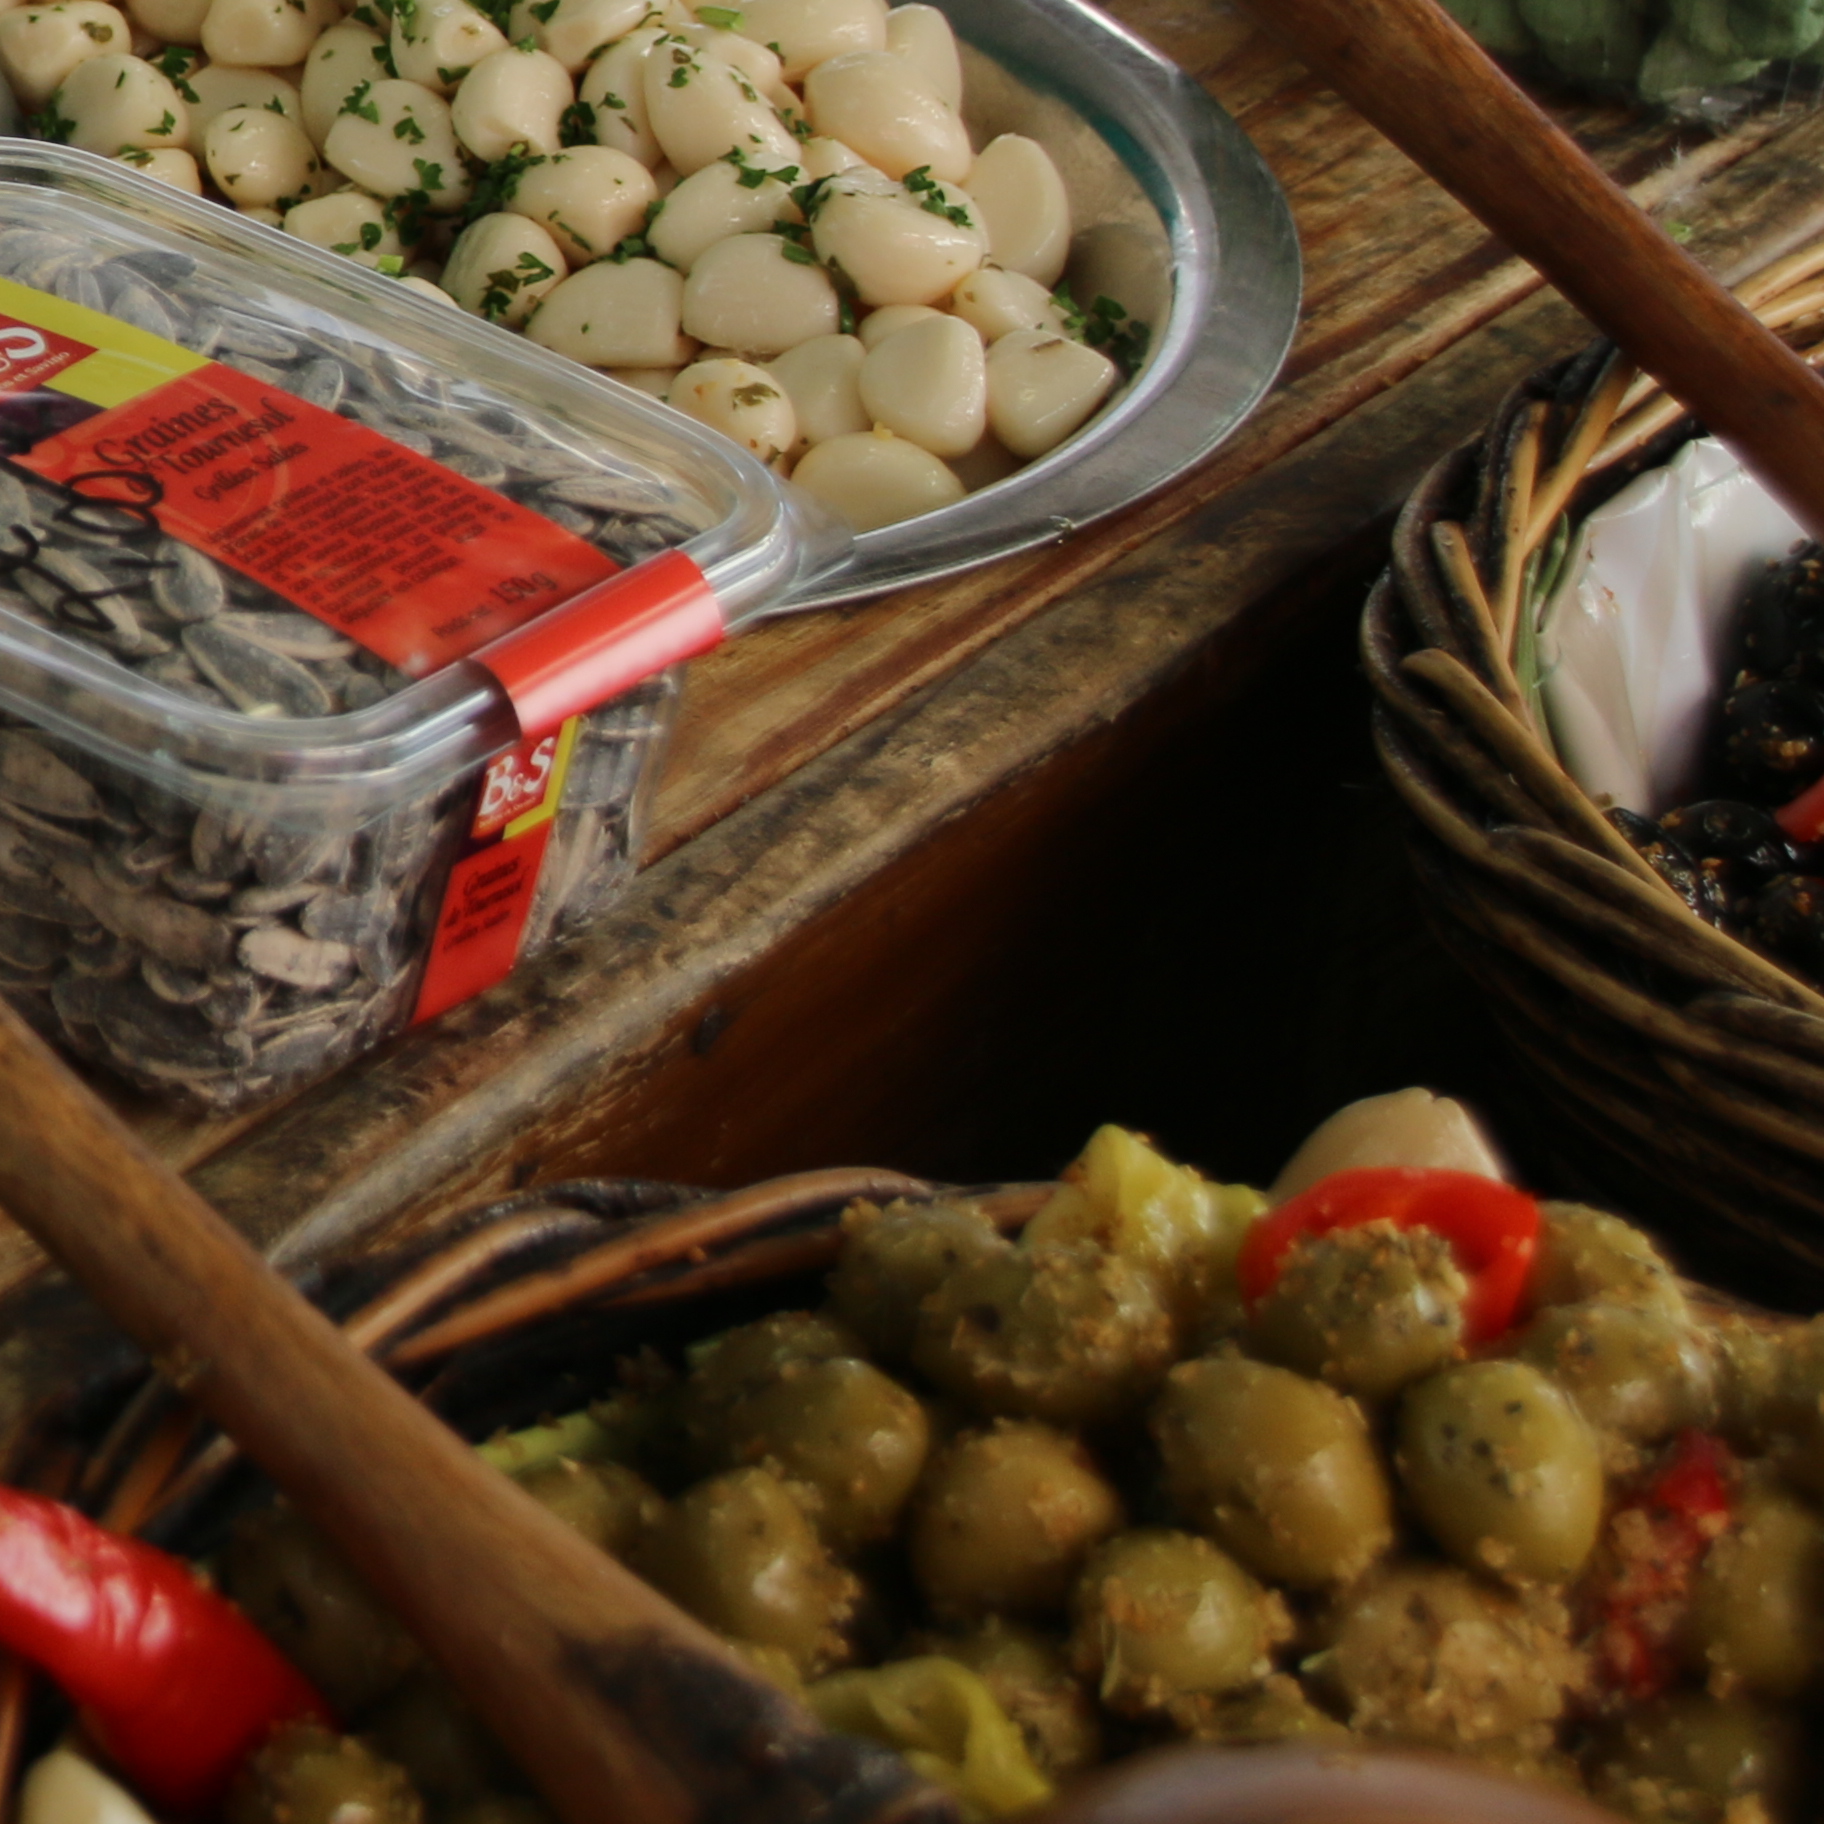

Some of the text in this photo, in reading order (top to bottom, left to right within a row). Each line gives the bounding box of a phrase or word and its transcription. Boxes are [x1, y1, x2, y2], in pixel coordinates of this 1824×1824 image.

[93, 396, 239, 473] Graines
[157, 395, 296, 475] Tournesol
[478, 736, 554, 816] B&S
